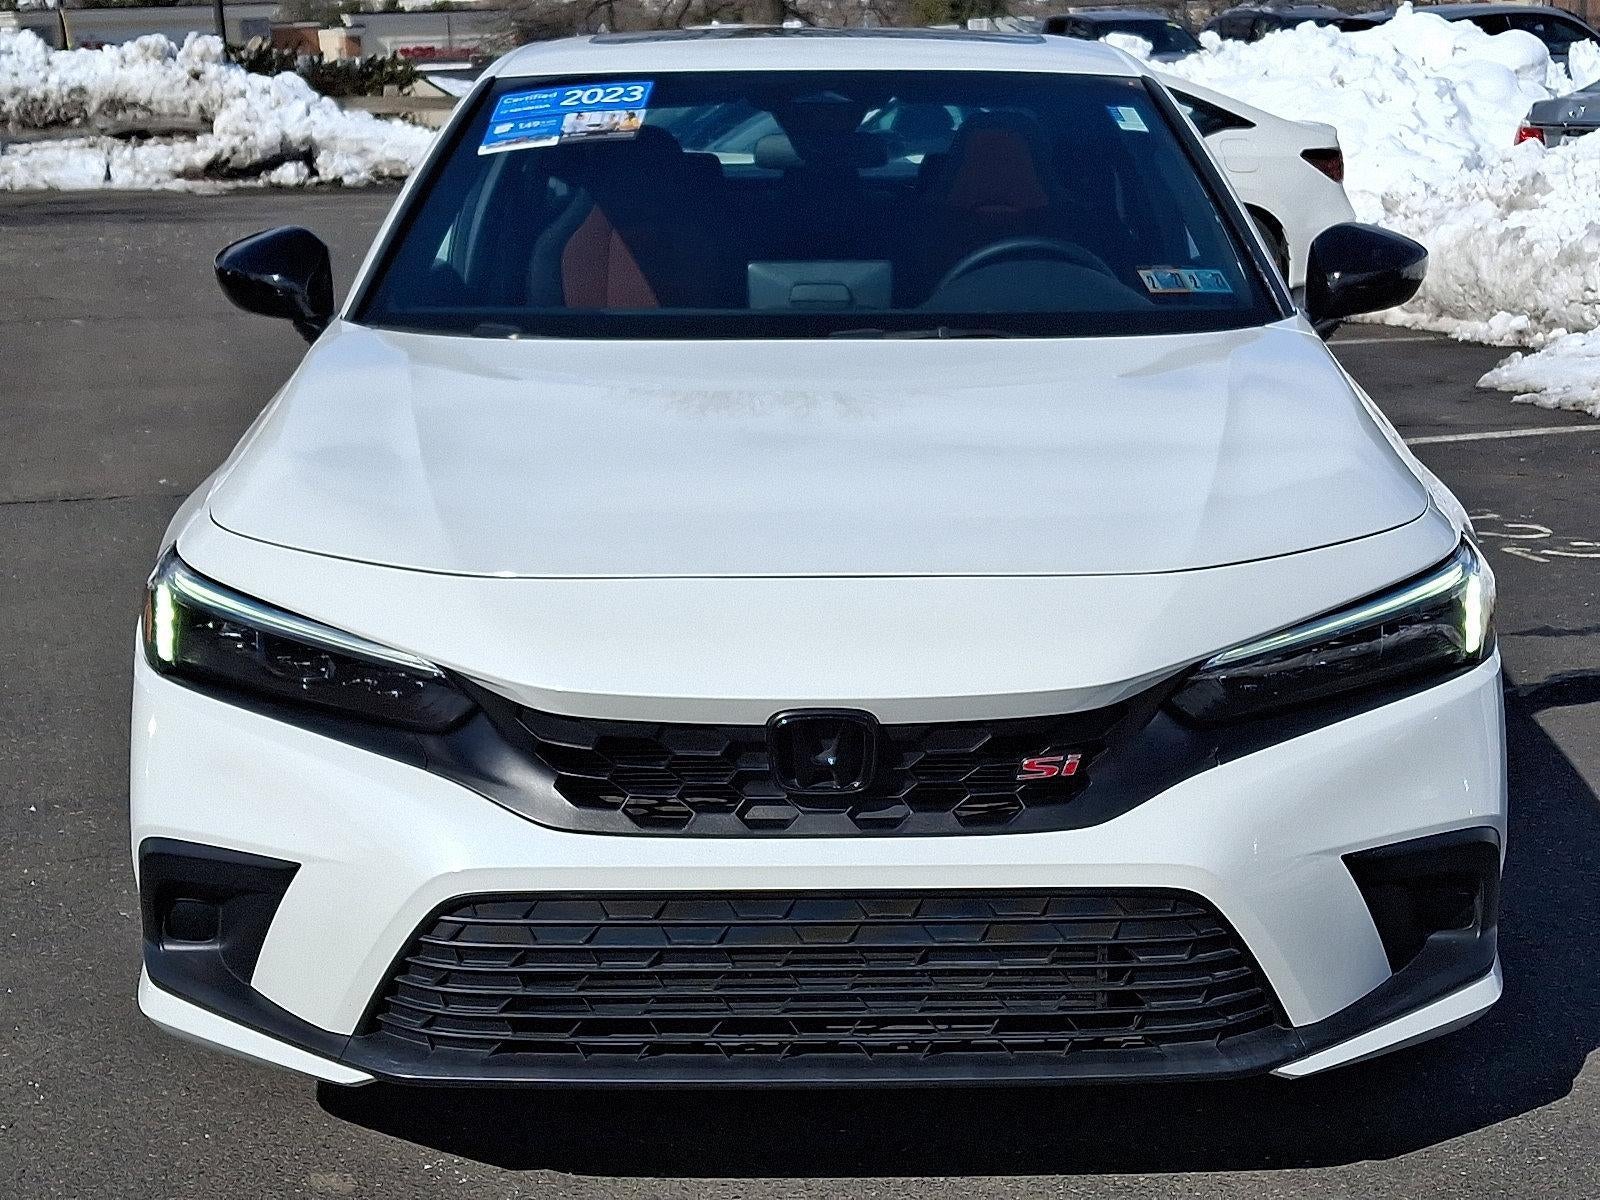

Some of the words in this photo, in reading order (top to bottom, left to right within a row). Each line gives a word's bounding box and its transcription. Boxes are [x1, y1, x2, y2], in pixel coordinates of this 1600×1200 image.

[503, 92, 557, 104] Certified
[560, 85, 644, 106] 2023
[1016, 754, 1082, 780] Si
